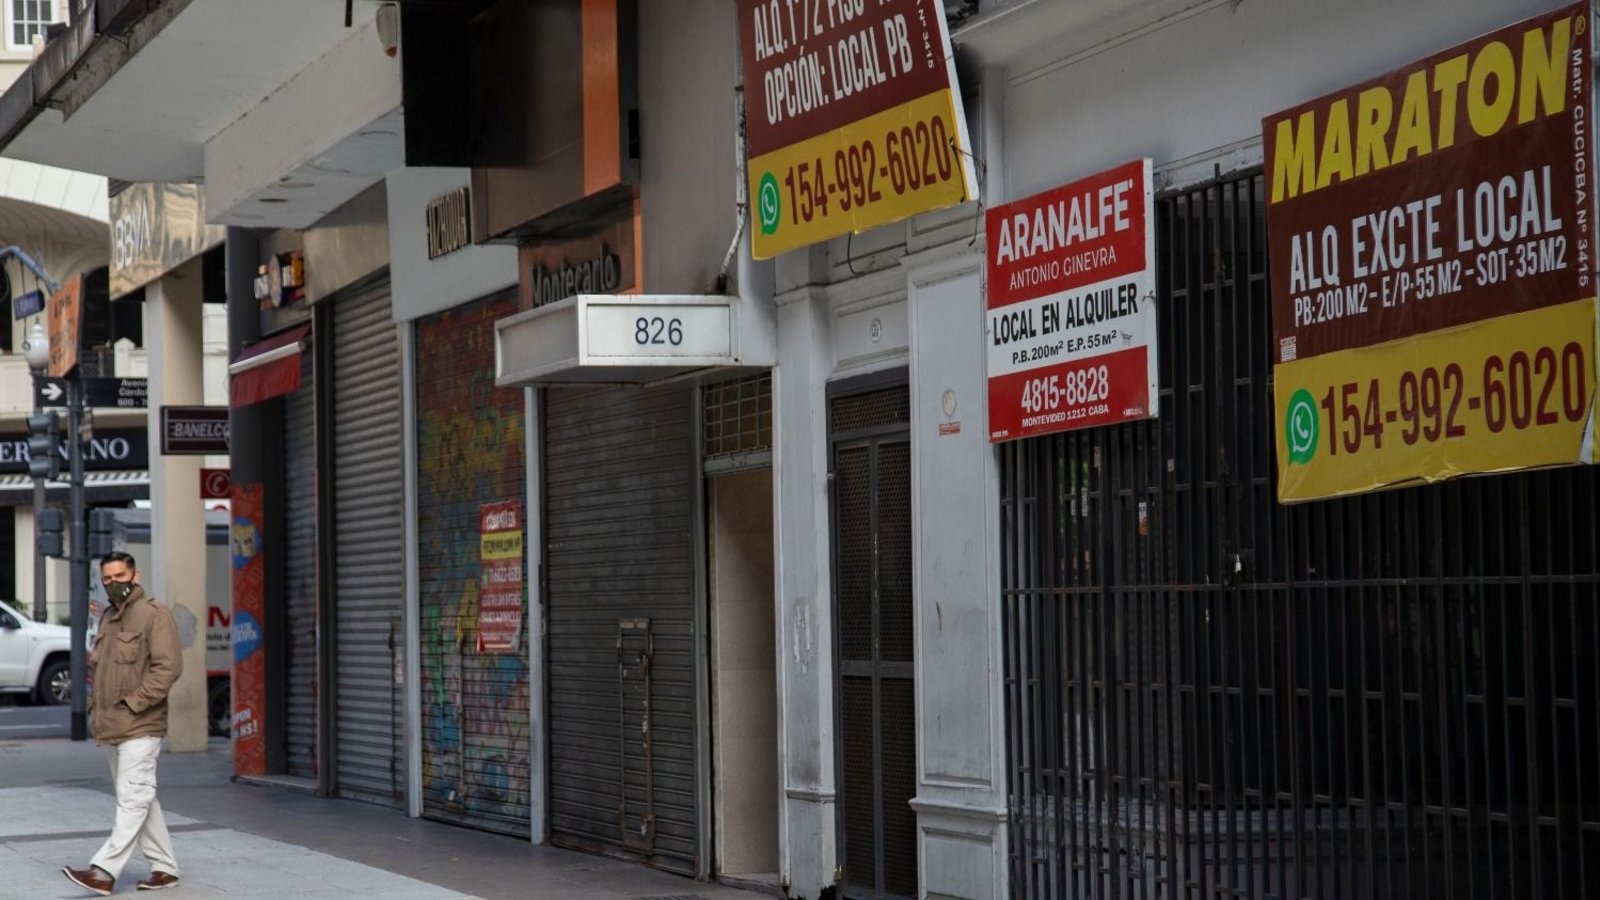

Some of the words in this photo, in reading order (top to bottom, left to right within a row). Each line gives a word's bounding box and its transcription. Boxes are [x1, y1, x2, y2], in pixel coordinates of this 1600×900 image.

[764, 45, 829, 125] OPCIÓN:
[828, 26, 886, 100] LOCAL
[883, 14, 913, 77] PB
[1572, 48, 1583, 99] Matr.
[1271, 16, 1571, 204] MARATON
[785, 115, 951, 225] 154-992-6020
[1574, 105, 1586, 205] CUCICBA
[115, 199, 150, 270] BBVA
[1290, 225, 1340, 294] ALQ
[1352, 194, 1443, 278] EXCTE
[1457, 165, 1562, 252] LOCAL
[1578, 239, 1589, 287] 3415
[1009, 259, 1060, 291] ANTONIO
[1063, 245, 1117, 277] GINEVRA
[635, 317, 682, 345] 826
[993, 308, 1036, 345] LOCAL
[1042, 301, 1060, 335] EN
[1066, 282, 1138, 329] ALQUILER
[1021, 365, 1109, 413] 4815-8828
[1022, 413, 1066, 427] MONTEVIDEO
[1067, 408, 1086, 420] 1212
[1088, 404, 1109, 416] CABA
[1321, 341, 1586, 455] 154-992-6020
